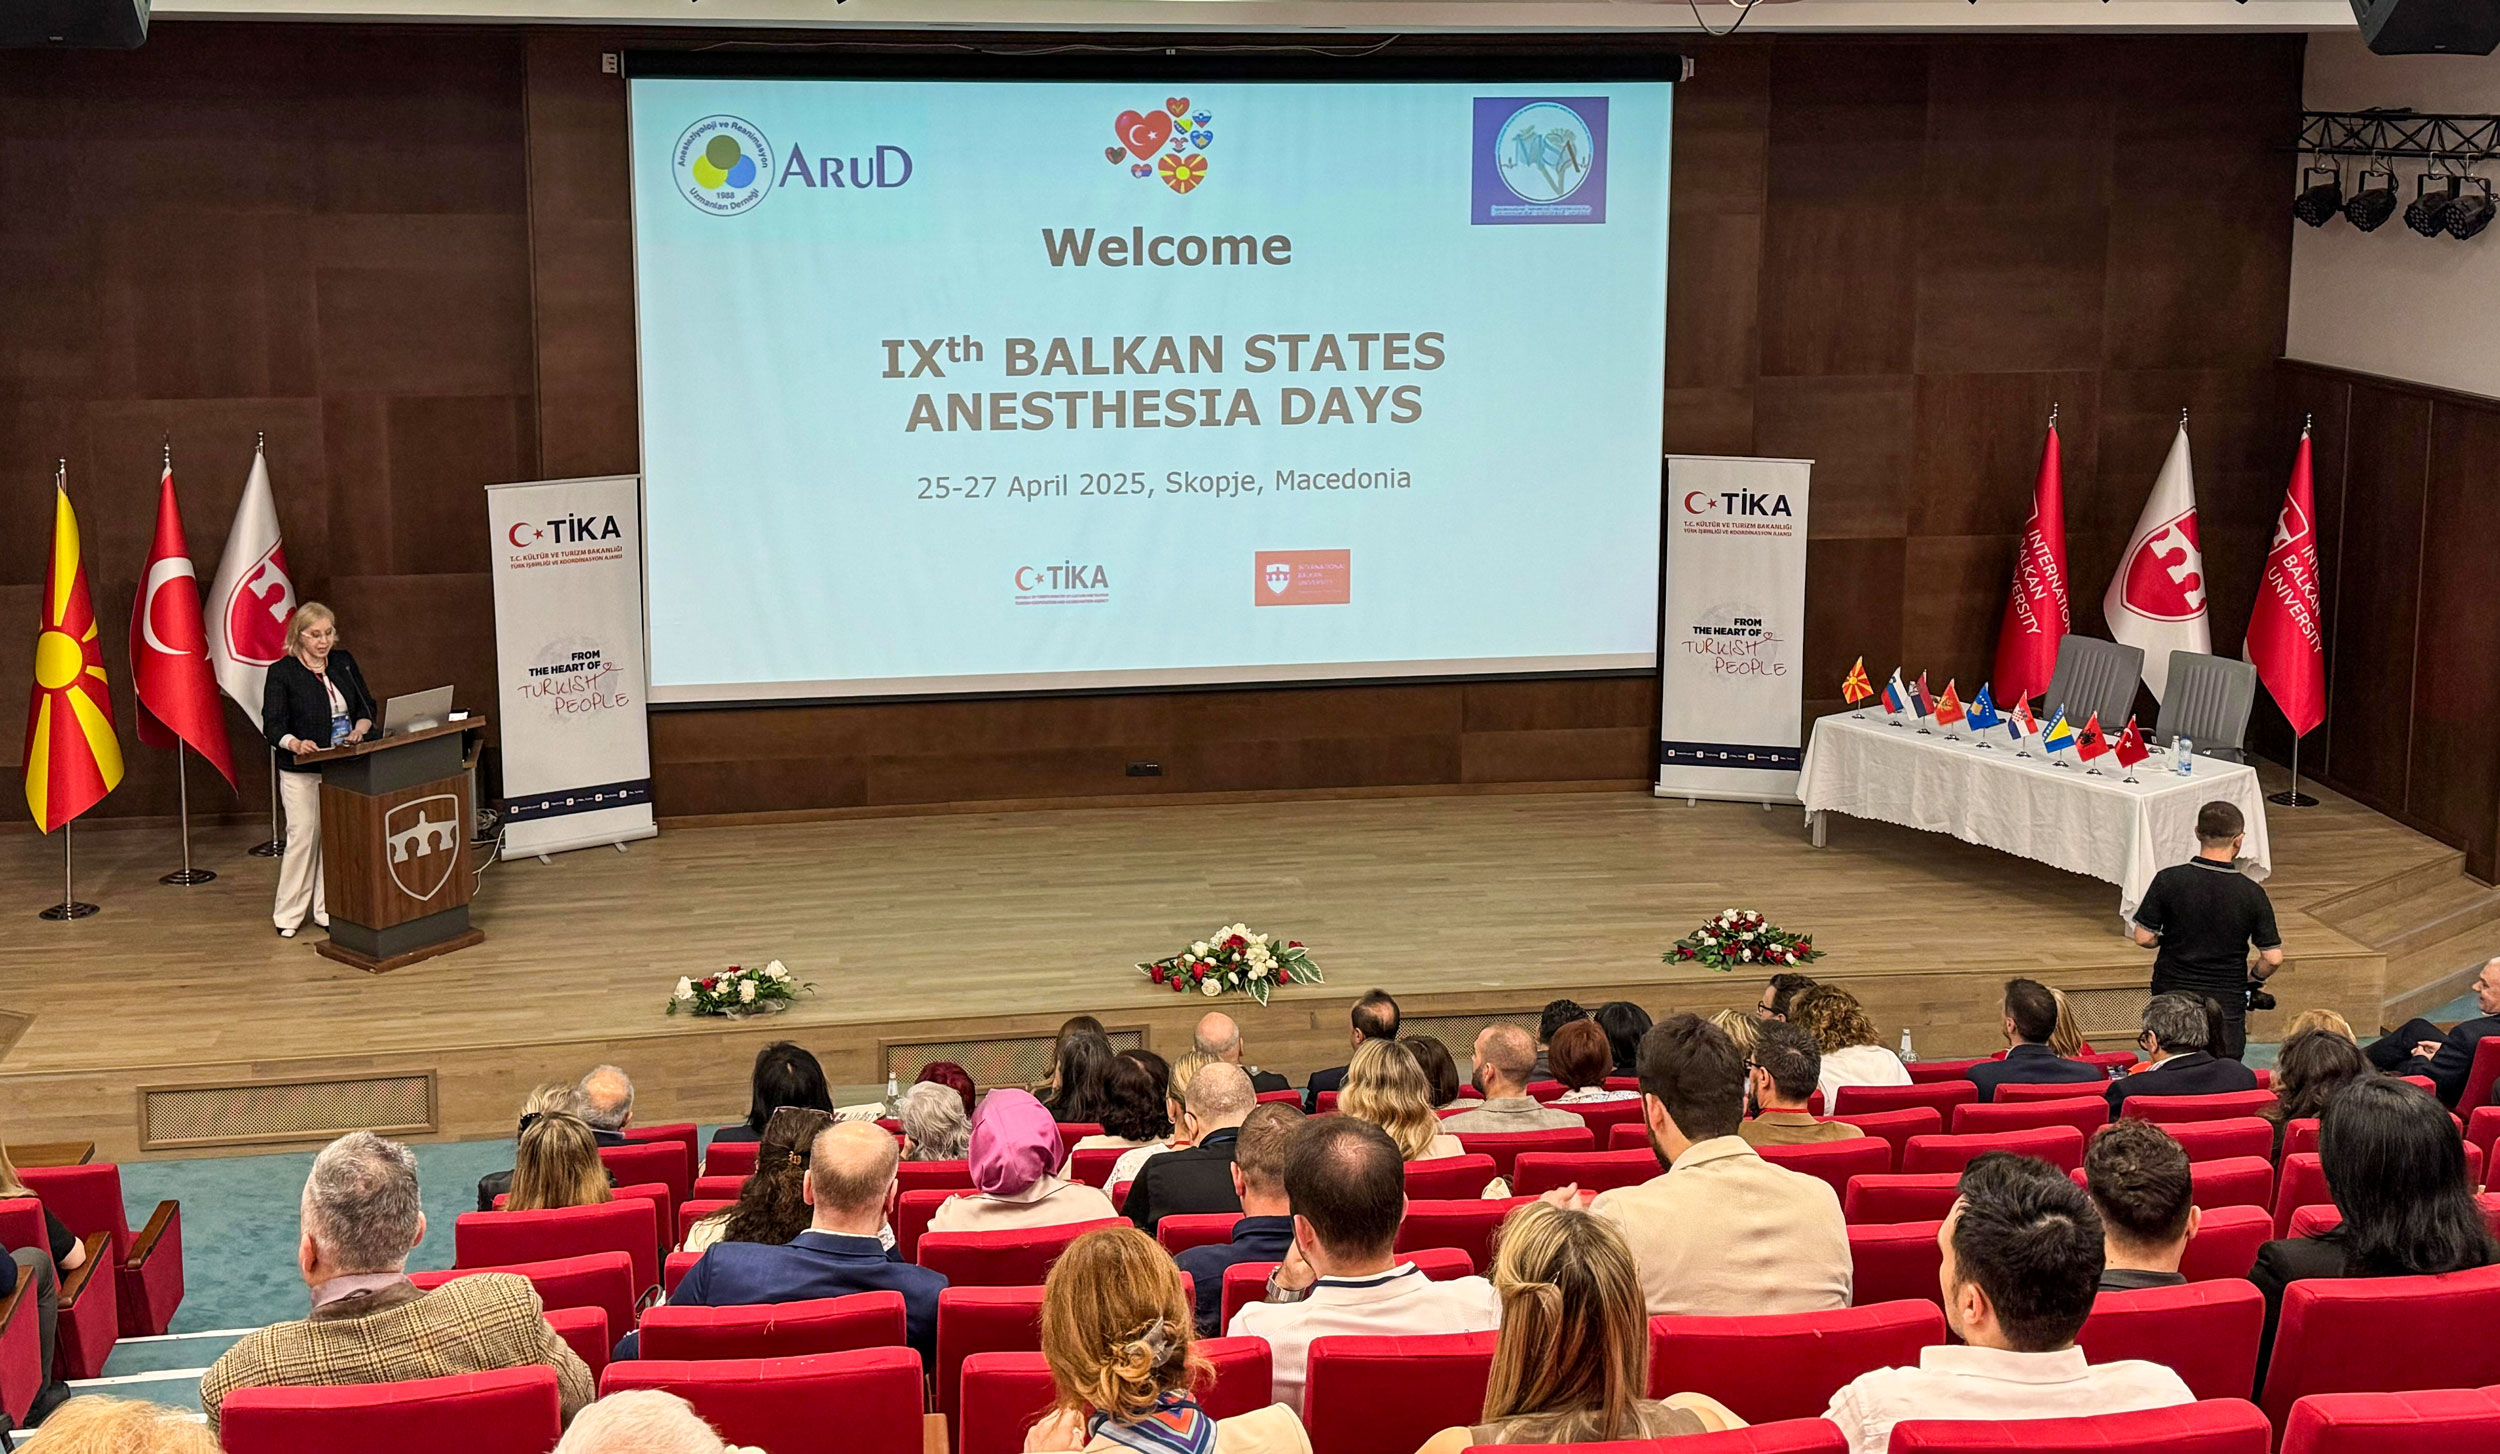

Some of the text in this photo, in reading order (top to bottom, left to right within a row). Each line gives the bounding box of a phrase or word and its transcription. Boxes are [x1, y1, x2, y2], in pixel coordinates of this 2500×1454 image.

[731, 121, 768, 169] Reanimasyon
[1042, 227, 1291, 267] Welcome
[882, 332, 1445, 378] IXth BALKAN STATES
[905, 385, 1422, 432] ANESTHESIA DAYS
[918, 468, 1411, 502] 25-27 April 2025, Skopje, Macedonia
[1721, 488, 1792, 517] TİKA
[547, 513, 621, 544] TİKA
[1046, 560, 1109, 590] TİKA
[2283, 554, 2320, 617] BALKAN
[1733, 618, 1762, 627] FROM
[2268, 566, 2322, 653] UNIVERSITY
[1693, 626, 1762, 637] THE HEART OF
[571, 650, 601, 661] FROM
[1681, 638, 1765, 657] TURKISH
[529, 661, 601, 677] THE HEART OF
[1715, 656, 1787, 676] PEOPLE
[518, 674, 604, 699] TURKISH
[555, 692, 630, 715] PEOPLE
